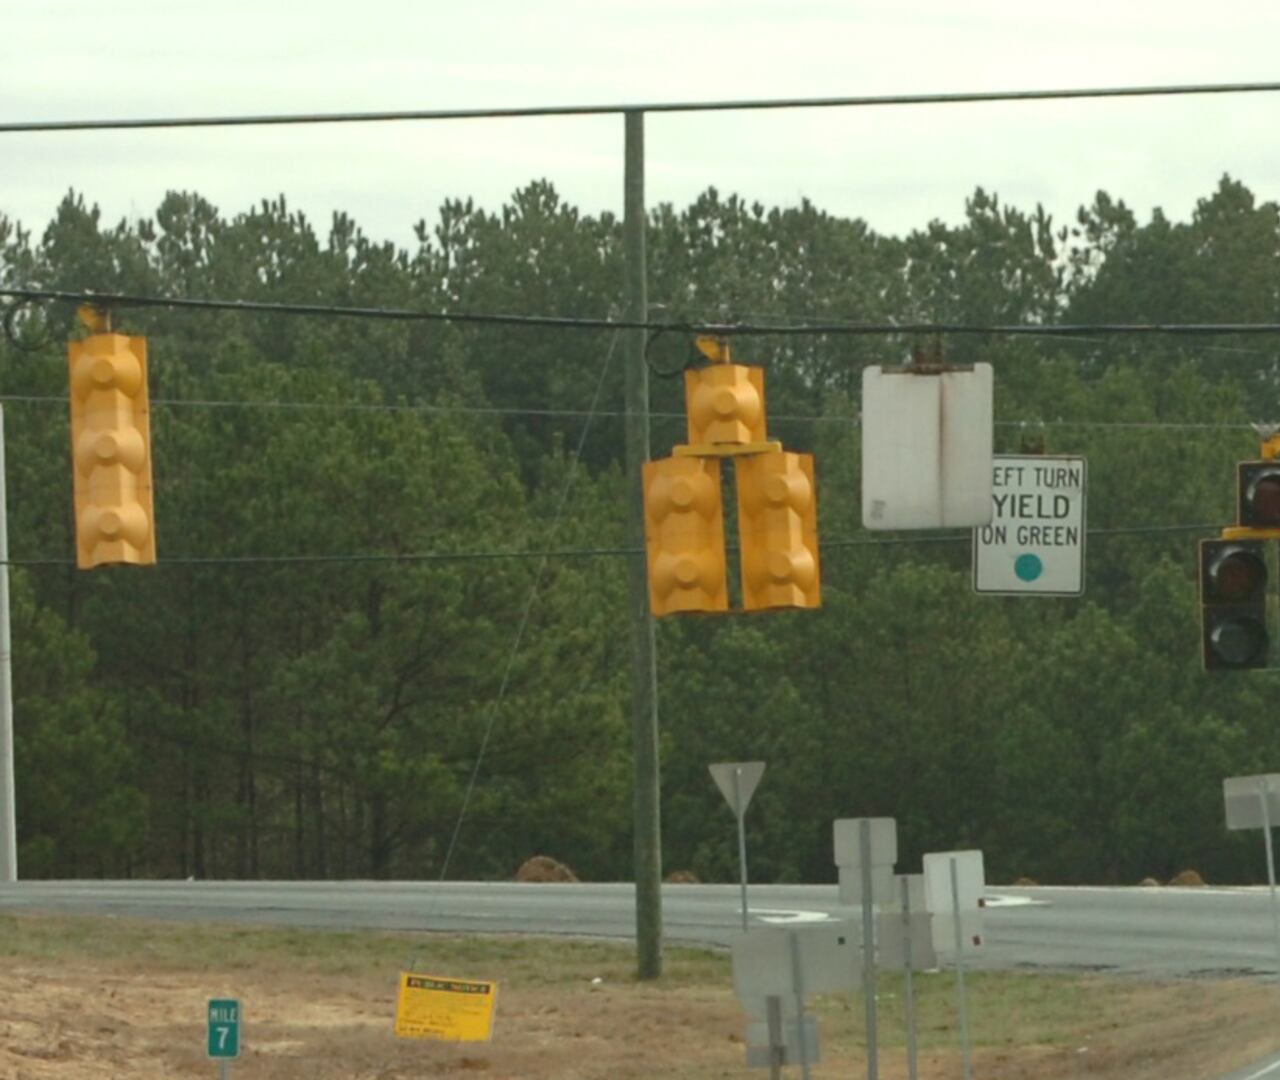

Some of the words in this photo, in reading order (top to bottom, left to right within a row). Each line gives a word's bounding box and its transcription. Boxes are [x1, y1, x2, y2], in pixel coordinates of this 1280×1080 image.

[993, 466, 1025, 486] EFT
[1033, 467, 1080, 488] TURN
[992, 493, 1071, 519] YIELD
[981, 525, 1007, 545] ON
[1016, 526, 1079, 546] GREEN
[209, 1007, 238, 1024] MILE
[216, 1026, 230, 1049] 7
